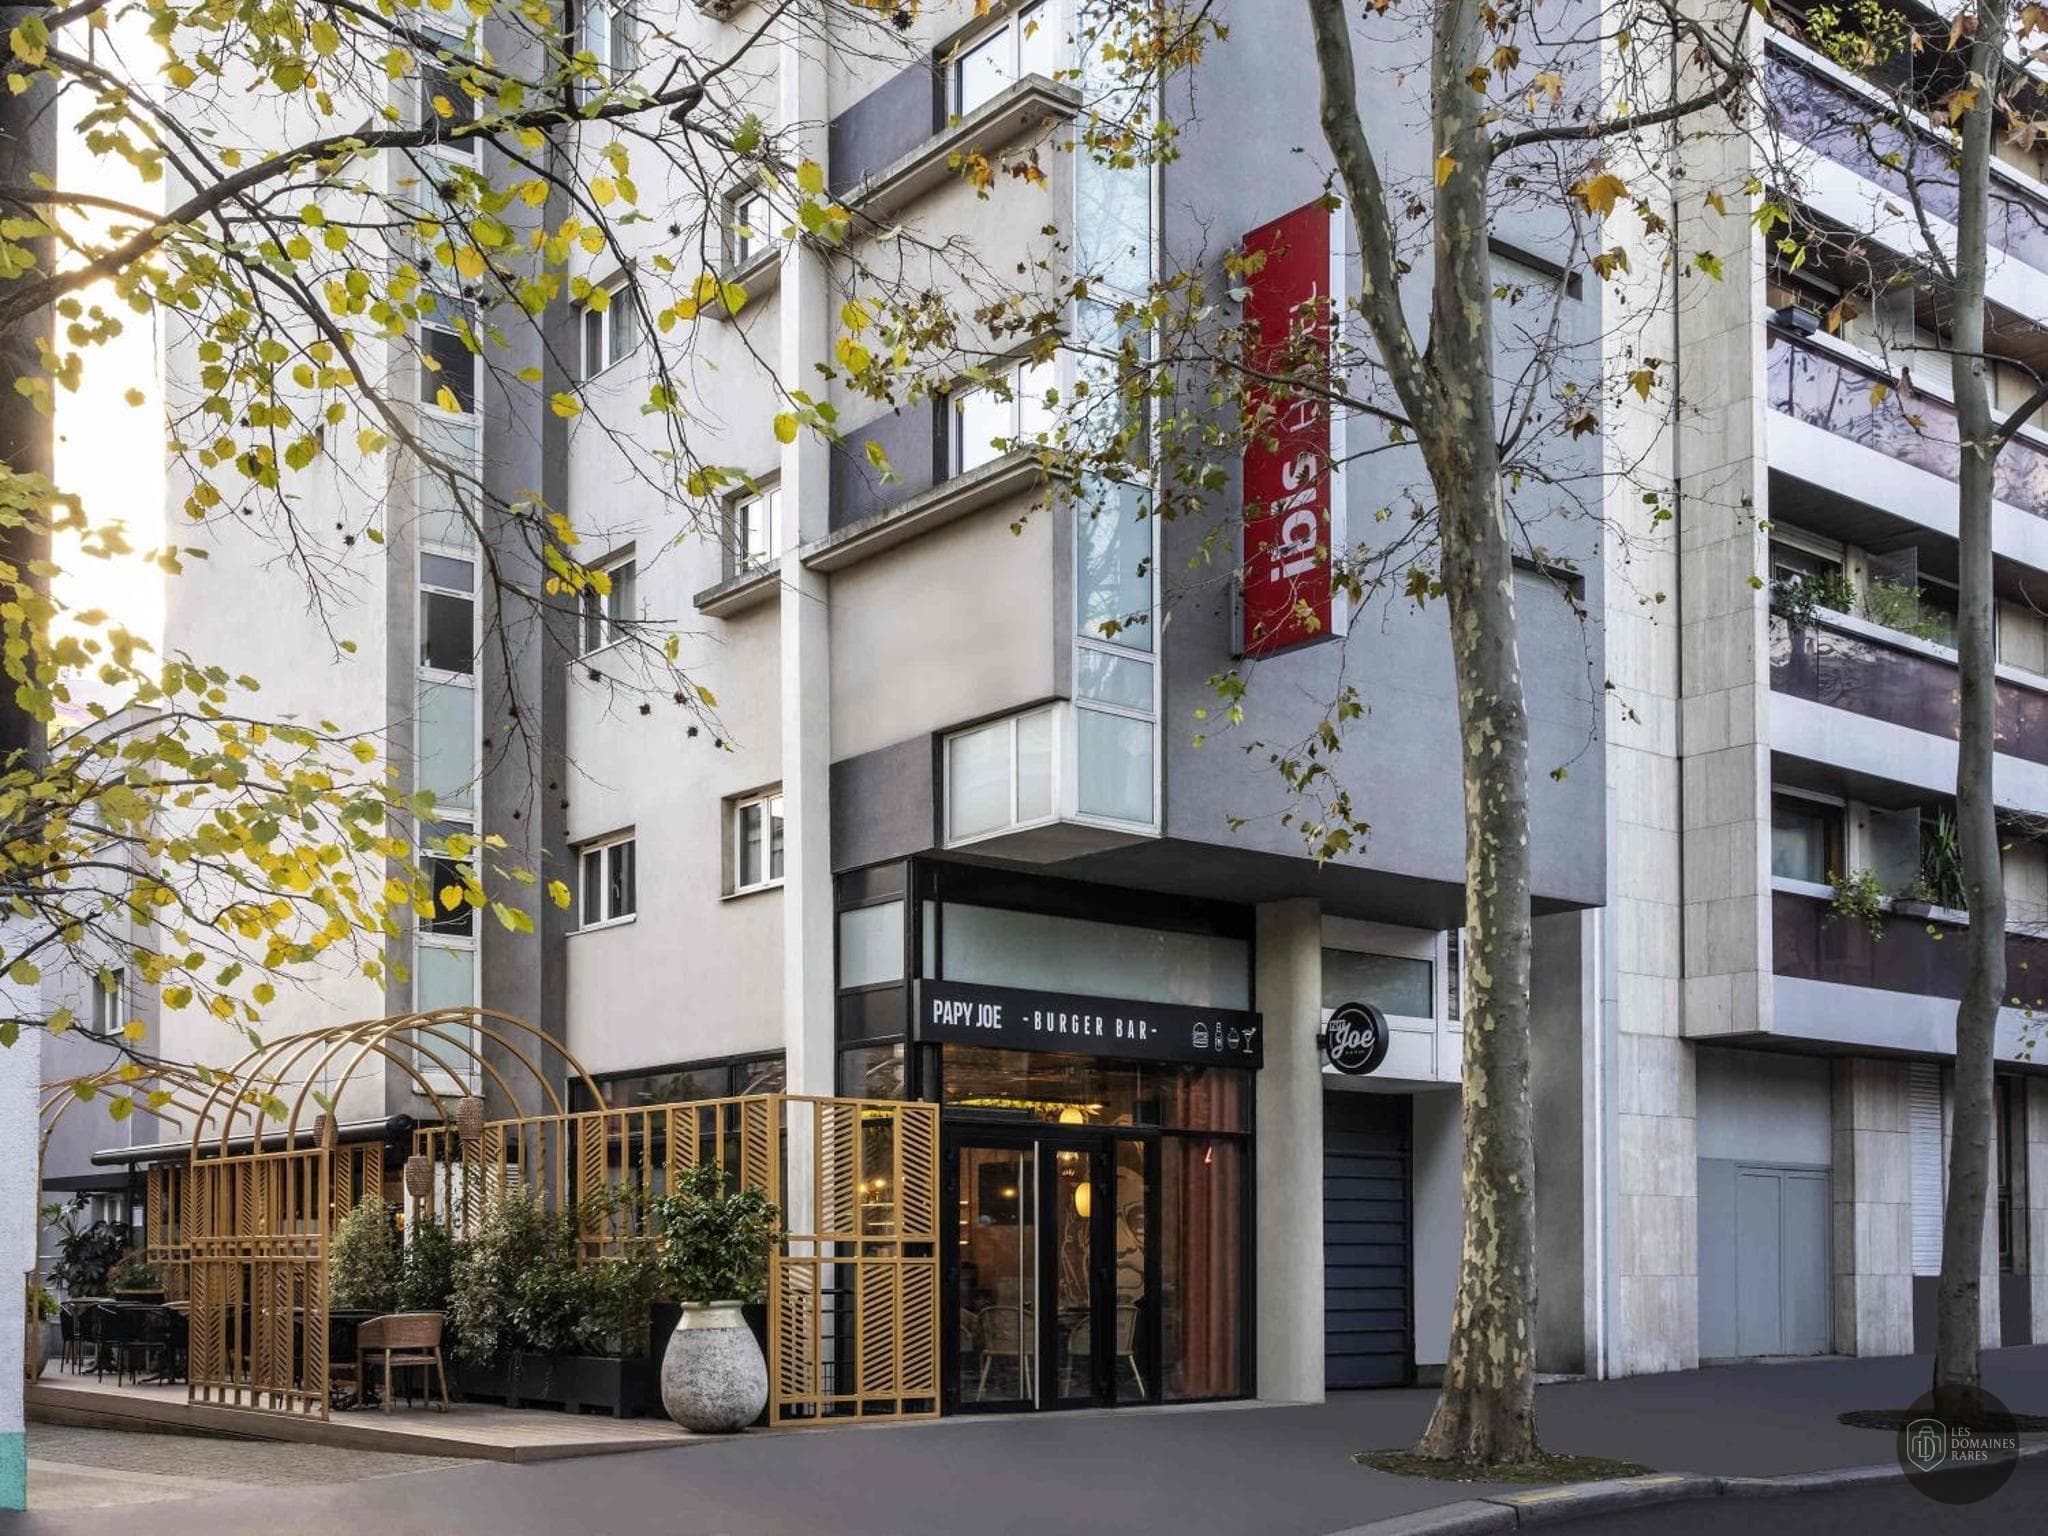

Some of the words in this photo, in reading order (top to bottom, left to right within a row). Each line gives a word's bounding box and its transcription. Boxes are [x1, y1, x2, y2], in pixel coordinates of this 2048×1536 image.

[1269, 453, 1318, 583] ibis
[933, 999, 973, 1026] PAPY
[976, 1005, 1002, 1029] JOE
[1331, 1022, 1375, 1059] Joe
